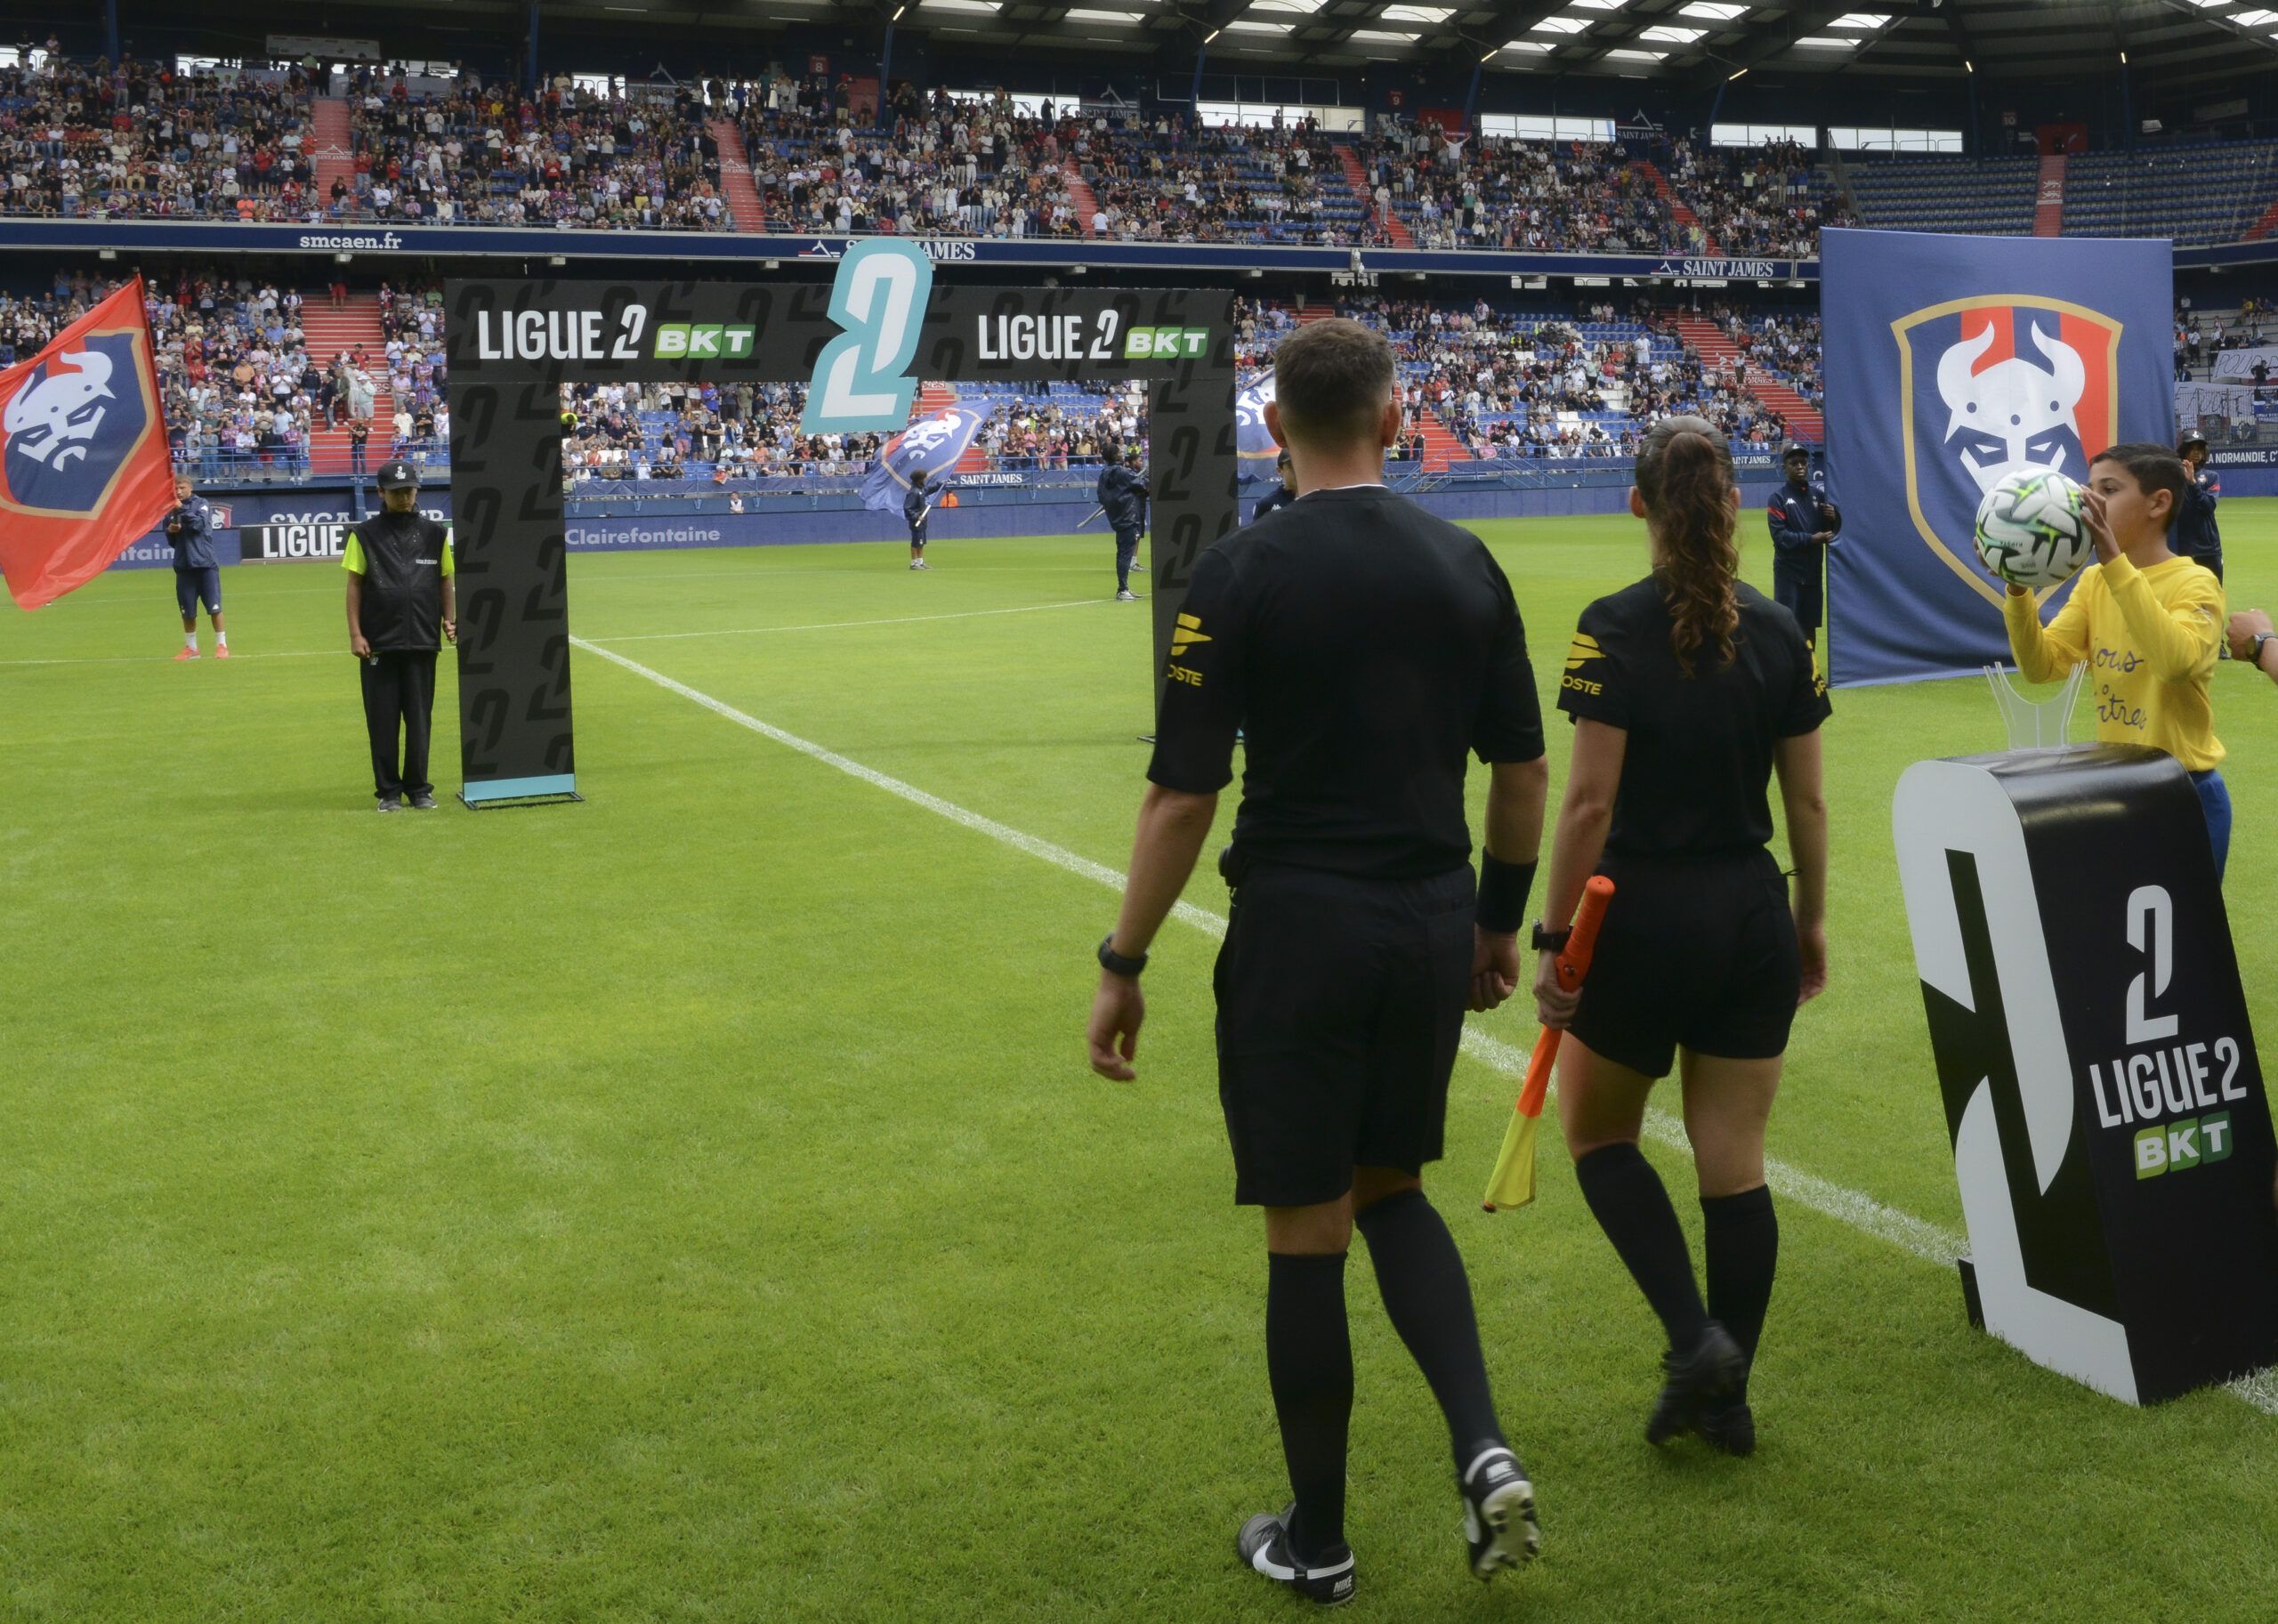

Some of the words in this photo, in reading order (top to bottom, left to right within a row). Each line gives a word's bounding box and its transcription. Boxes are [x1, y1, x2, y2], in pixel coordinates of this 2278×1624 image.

[300, 231, 402, 249] smcaen.fr
[1683, 260, 1727, 276] SAINT
[1727, 262, 1773, 278] JAMES
[478, 311, 604, 360] LIGUE
[611, 304, 647, 359] 2
[658, 330, 752, 351] BKT
[978, 314, 1084, 360] LIGUE
[1089, 309, 1119, 359] 2
[1127, 333, 1207, 352] BKT
[2215, 451, 2268, 464] NORMANDIE,
[960, 474, 989, 485] SAINT
[990, 473, 1022, 484] JAMES
[263, 525, 344, 558] LIGUE
[565, 527, 722, 545] Clairefontaine
[1562, 675, 1603, 695] OSTE
[2126, 885, 2178, 1046] 2
[2137, 1119, 2228, 1171] BKT
